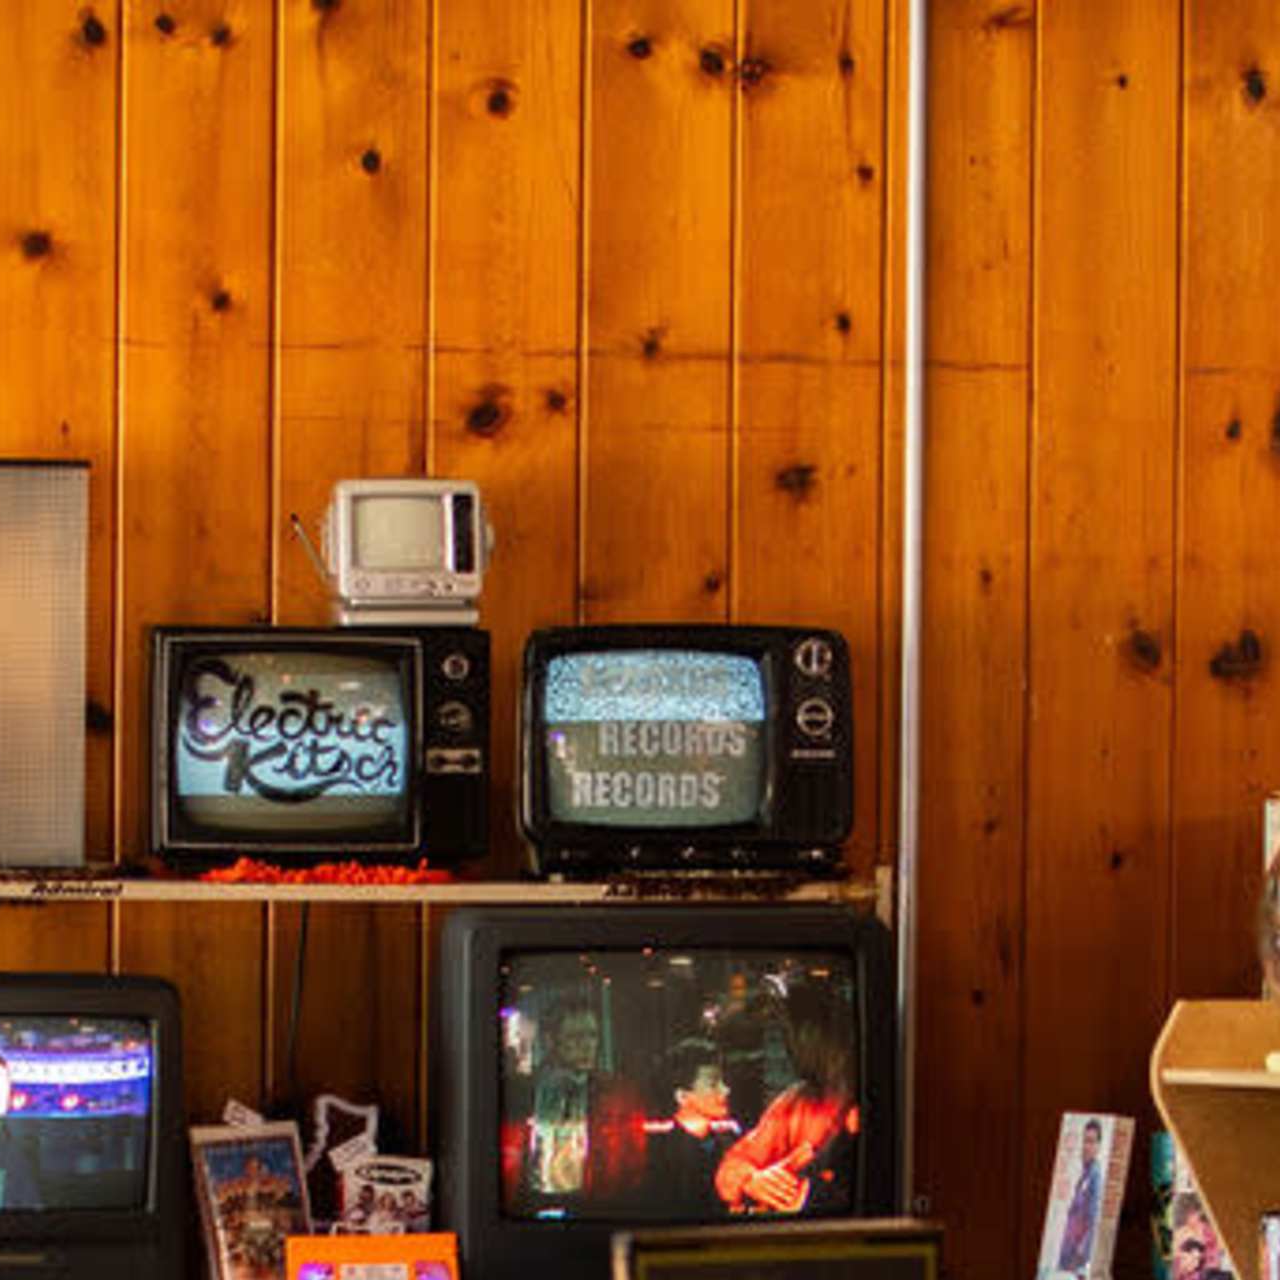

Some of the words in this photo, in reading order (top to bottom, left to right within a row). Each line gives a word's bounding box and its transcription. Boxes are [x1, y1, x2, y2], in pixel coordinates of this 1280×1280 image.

[184, 658, 398, 746] Electric
[597, 719, 748, 759] RECORDS
[190, 736, 401, 804] Kitsch
[570, 771, 724, 809] RECORDS
